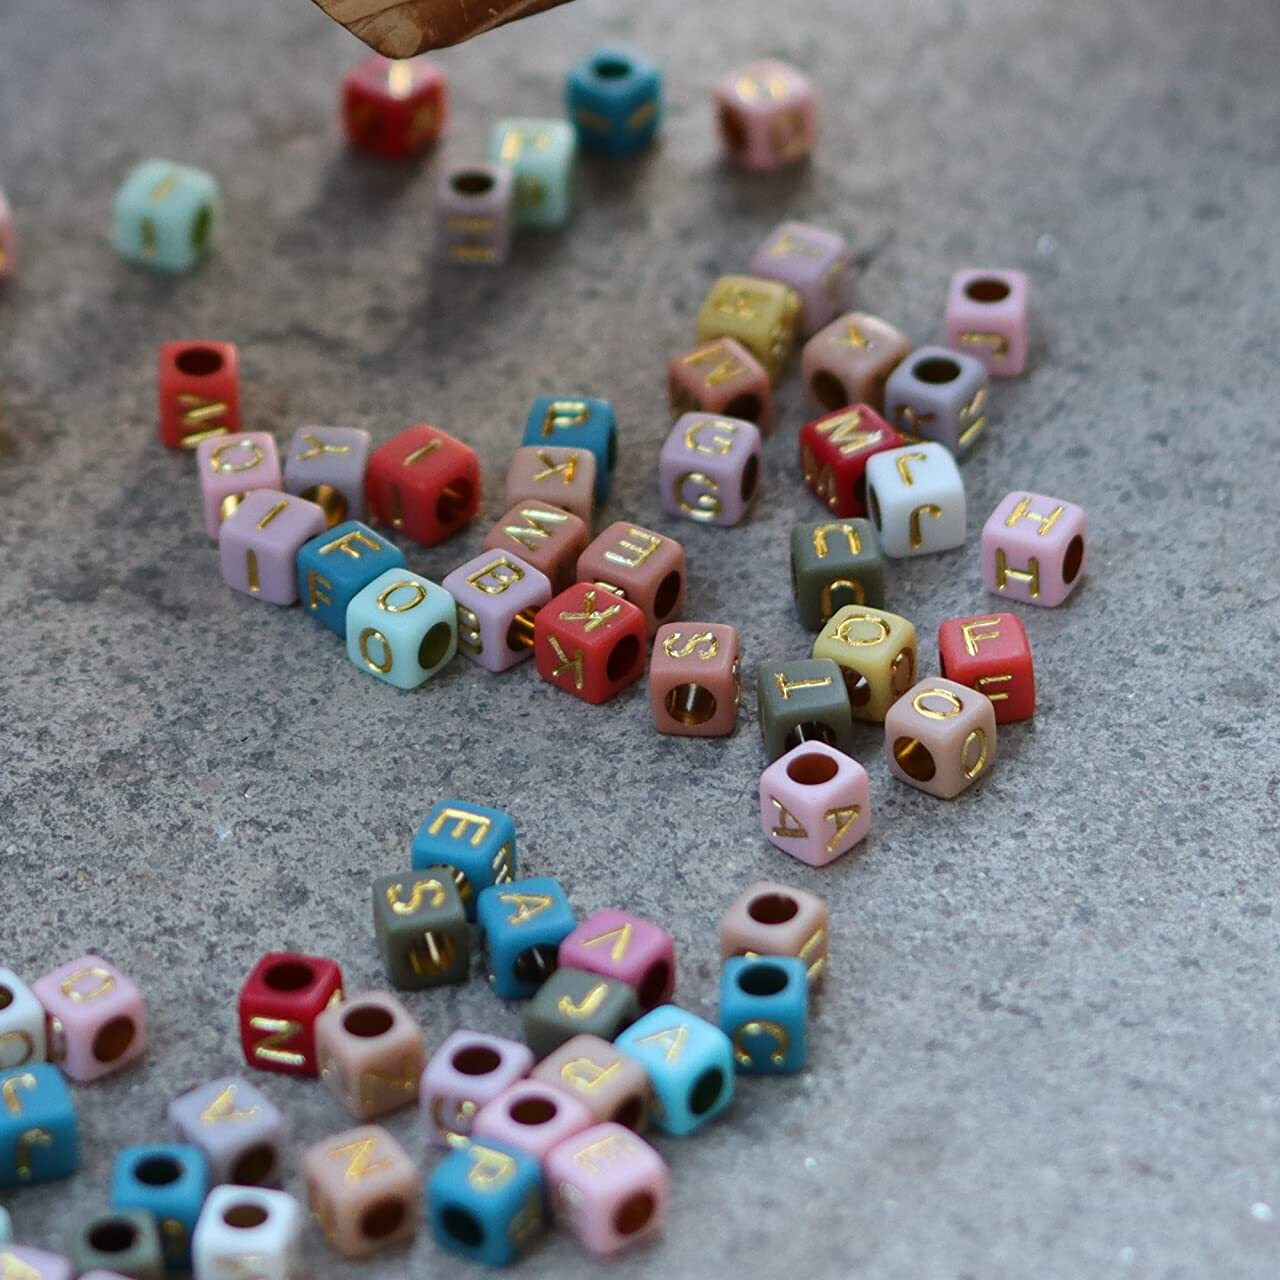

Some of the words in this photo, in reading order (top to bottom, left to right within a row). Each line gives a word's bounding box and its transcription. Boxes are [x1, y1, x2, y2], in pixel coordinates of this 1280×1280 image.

[540, 400, 592, 439] P
[683, 419, 738, 456] G
[294, 432, 354, 463] Y
[532, 449, 580, 485] K
[255, 499, 290, 531] I
[672, 471, 723, 523] G
[1003, 496, 1067, 537] H
[317, 529, 383, 559] F
[602, 525, 663, 570] E
[464, 554, 526, 596] B
[994, 546, 1040, 600] H
[375, 579, 428, 615] O
[558, 590, 623, 633] K
[357, 625, 394, 675] O
[661, 631, 720, 662] S
[825, 614, 892, 648] Q
[960, 616, 1003, 658] F
[546, 633, 586, 692] K
[911, 687, 964, 721] O
[426, 807, 492, 846] E
[385, 877, 448, 916] S
[497, 891, 555, 926] A
